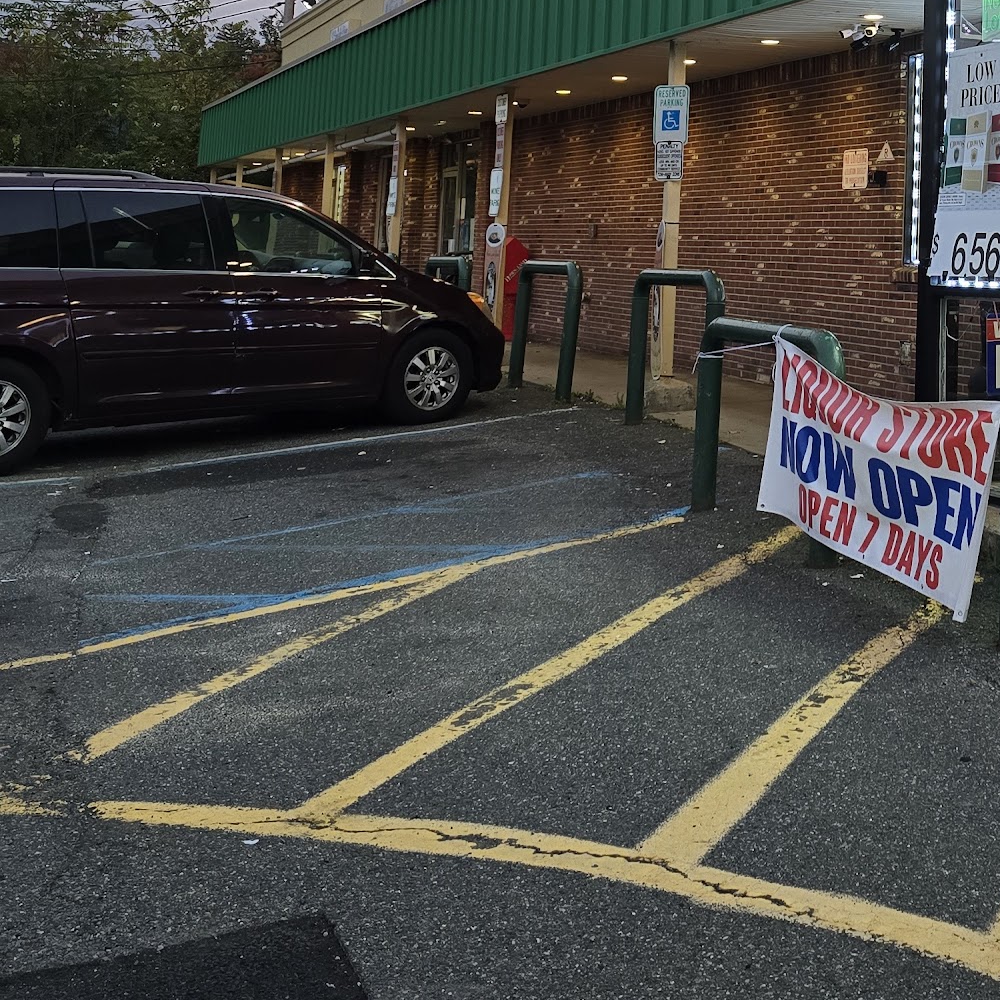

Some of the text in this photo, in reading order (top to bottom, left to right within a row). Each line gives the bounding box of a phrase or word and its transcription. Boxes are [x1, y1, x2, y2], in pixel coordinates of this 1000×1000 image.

[966, 60, 997, 83] LOW
[658, 89, 686, 98] RESERVED
[660, 99, 683, 107] PARKING
[961, 83, 1000, 108] PRICE
[781, 353, 993, 486] LIQUOR STORE
[779, 416, 982, 551] NOW OPEN
[799, 483, 943, 590] OPEN 7 DAYS
